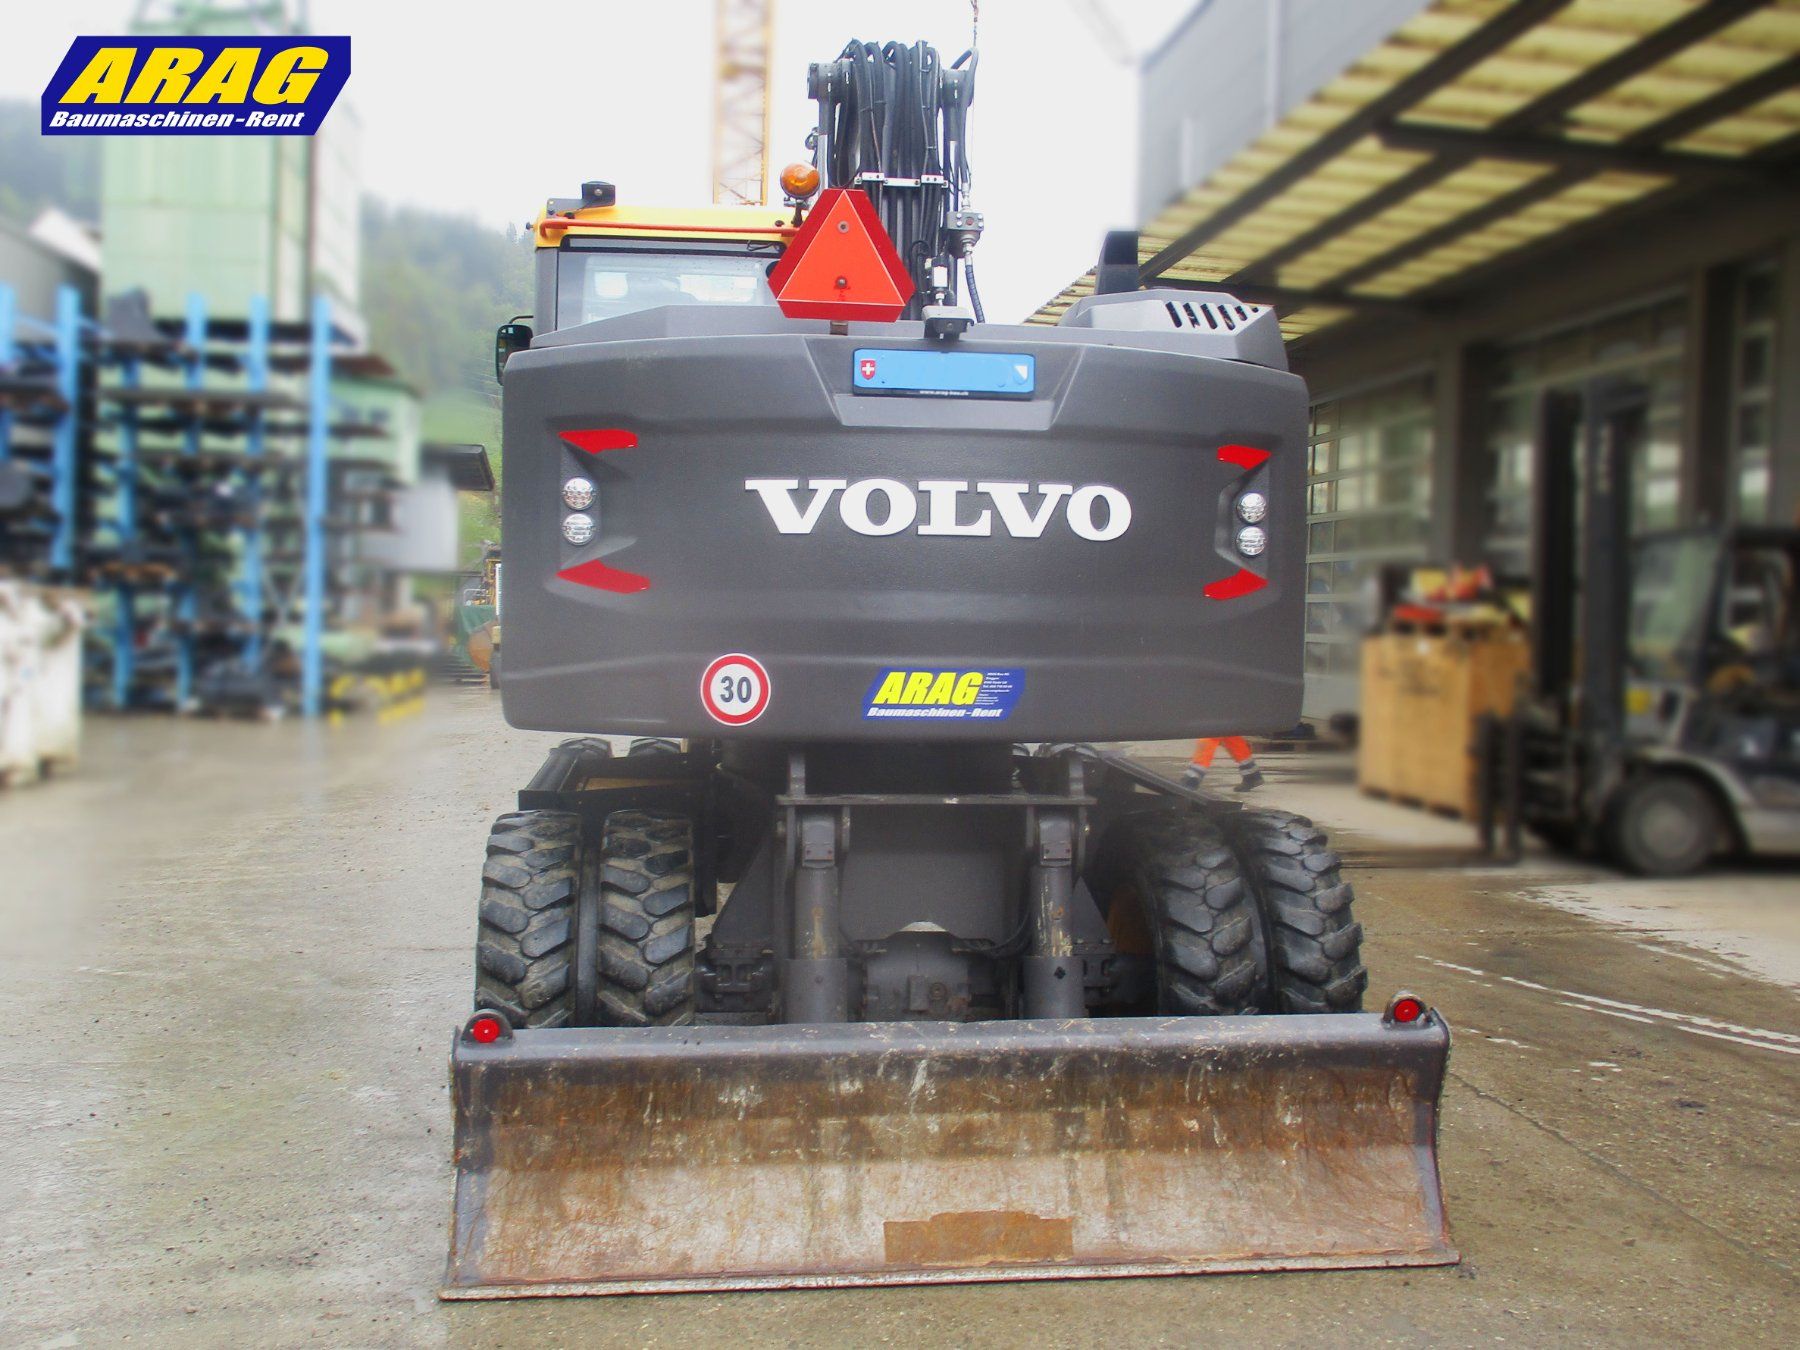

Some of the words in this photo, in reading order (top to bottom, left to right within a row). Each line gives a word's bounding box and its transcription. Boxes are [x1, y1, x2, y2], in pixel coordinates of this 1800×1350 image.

[744, 478, 1132, 541] VOLVO
[720, 676, 752, 703] 30
[873, 671, 984, 706] ARAG
